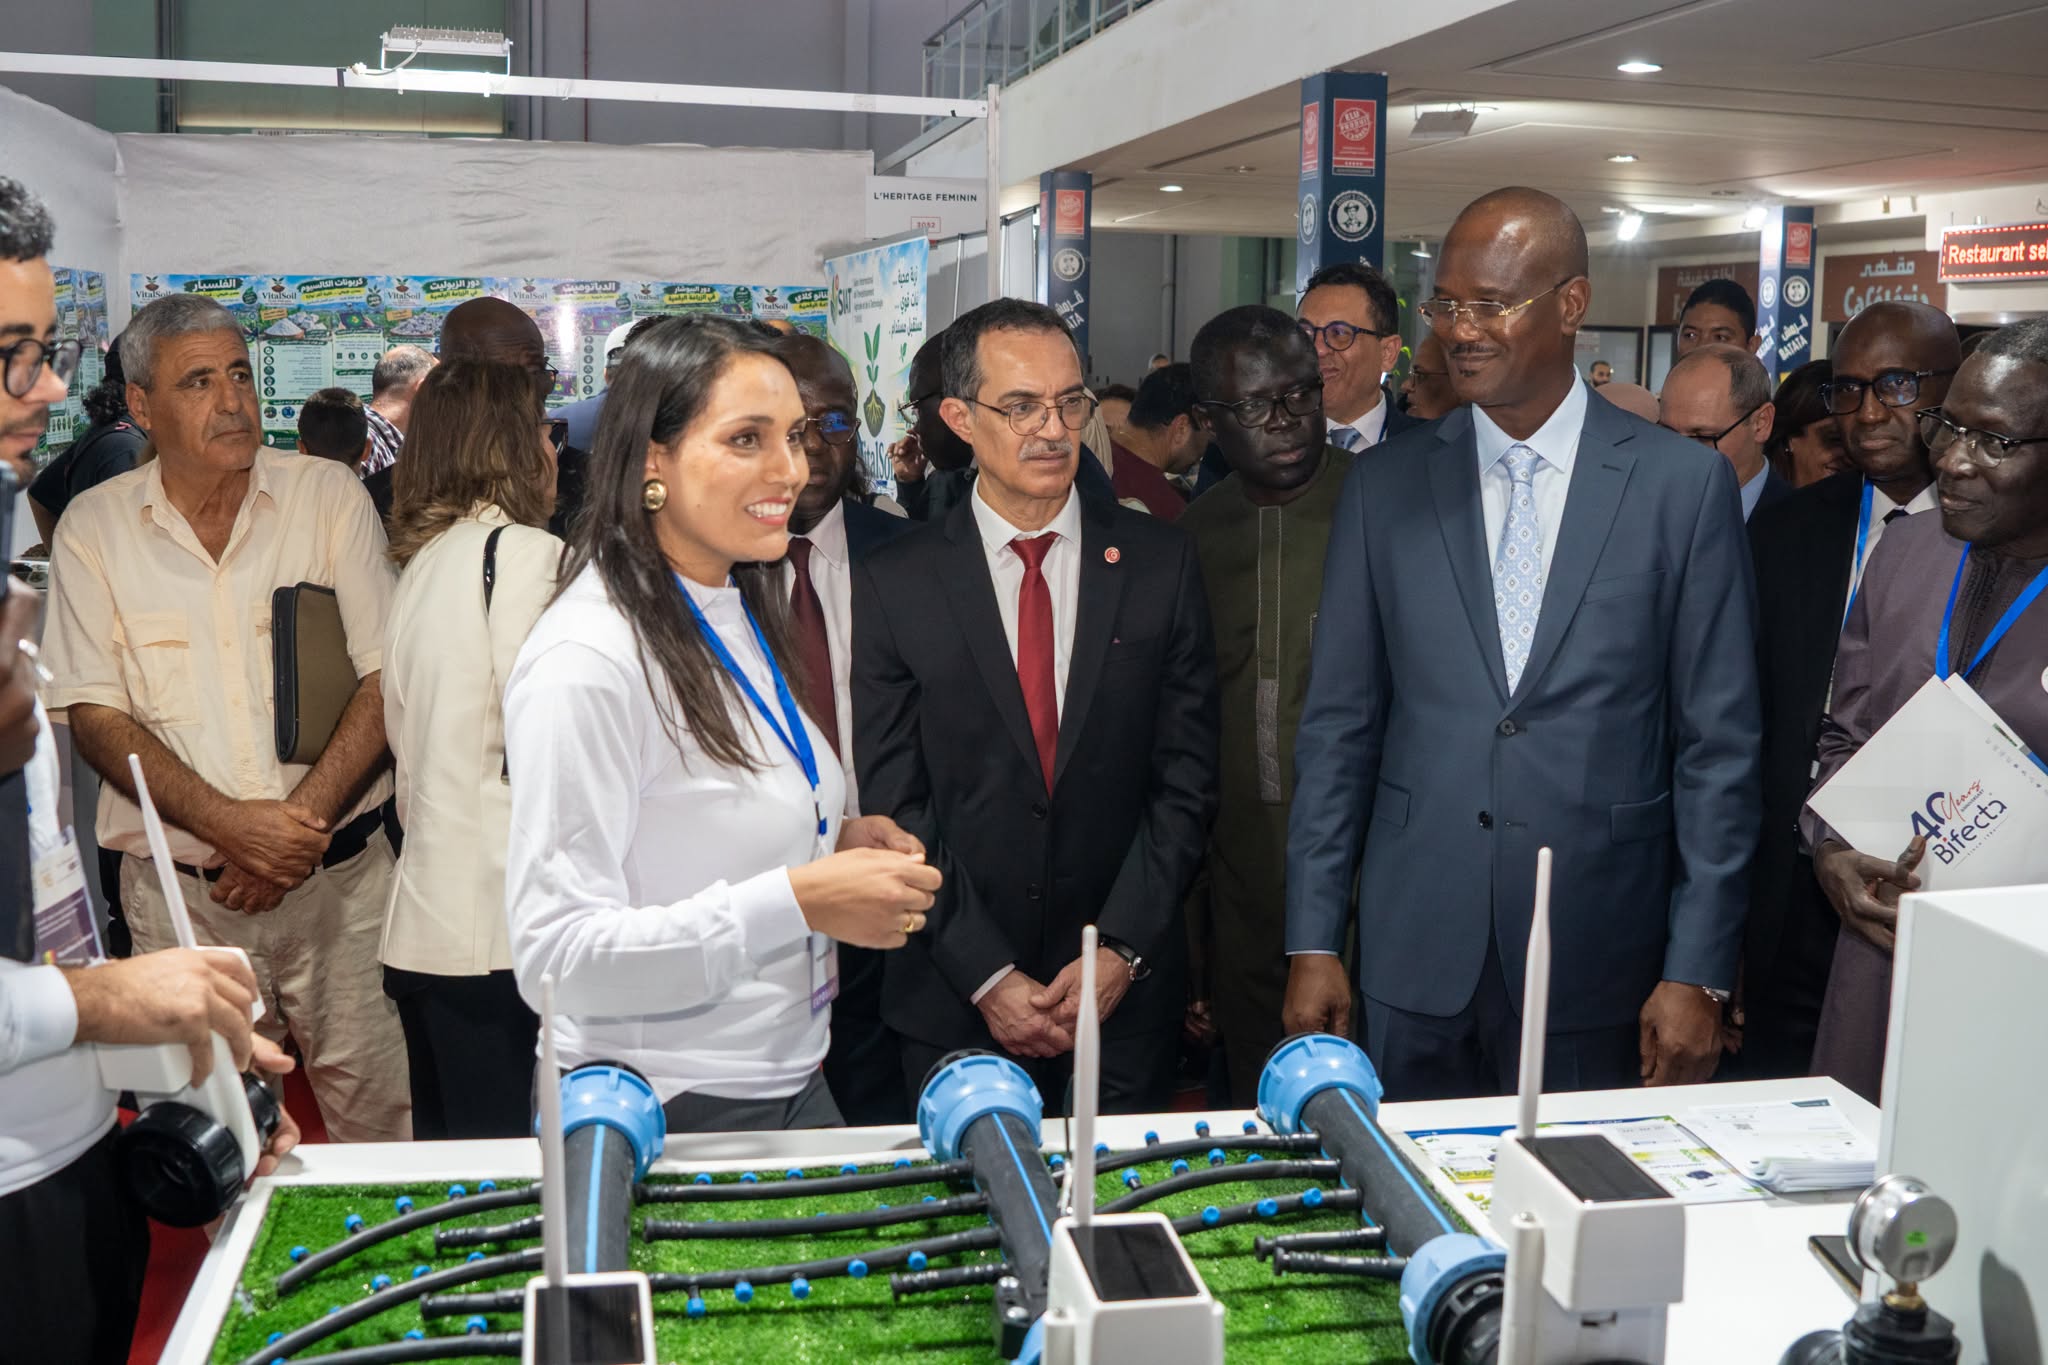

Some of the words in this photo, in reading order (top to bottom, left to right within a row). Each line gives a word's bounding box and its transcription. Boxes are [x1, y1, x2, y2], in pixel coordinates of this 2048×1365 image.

[873, 192, 933, 201] L'HERITAGE
[935, 194, 978, 202] FEMININ
[1947, 240, 2026, 265] Restaurant
[1859, 257, 1916, 278] مقهى
[262, 292, 297, 300] VitalSoil
[388, 292, 421, 300] VitalSoil
[513, 291, 548, 299] VitalSoil
[757, 302, 788, 310] VitalSoil
[1778, 334, 1809, 361] BATATA
[1911, 792, 1945, 840] 40
[1941, 779, 1980, 822] Years
[1932, 800, 2008, 865] Bifecta
